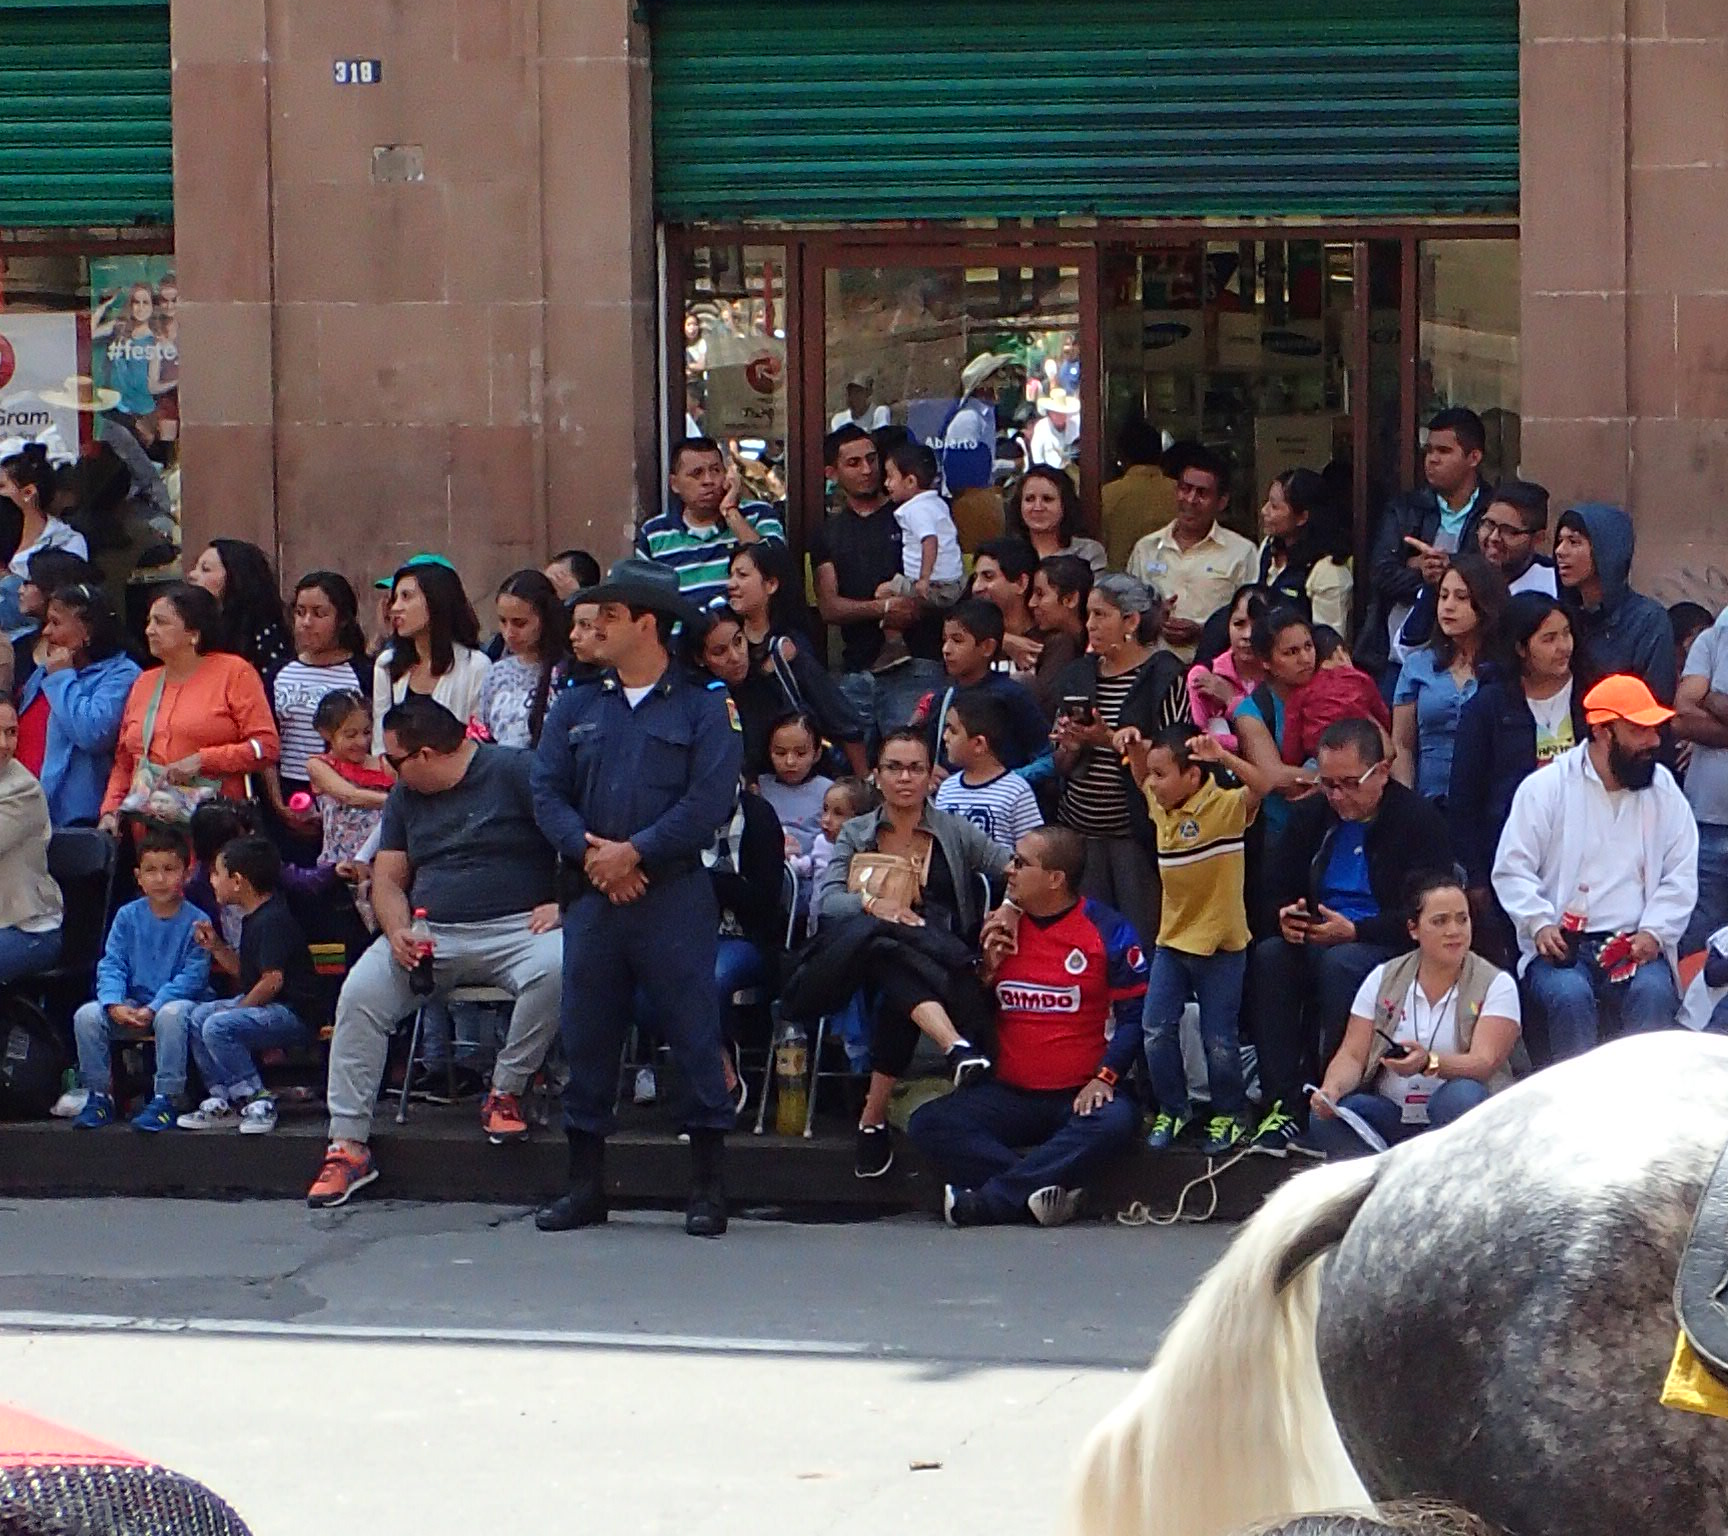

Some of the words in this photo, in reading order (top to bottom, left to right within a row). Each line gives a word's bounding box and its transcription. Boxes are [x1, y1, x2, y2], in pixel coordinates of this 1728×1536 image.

[335, 61, 372, 83] 318
[925, 436, 978, 451] Abierto
[1000, 989, 1073, 1010] BIMBO
